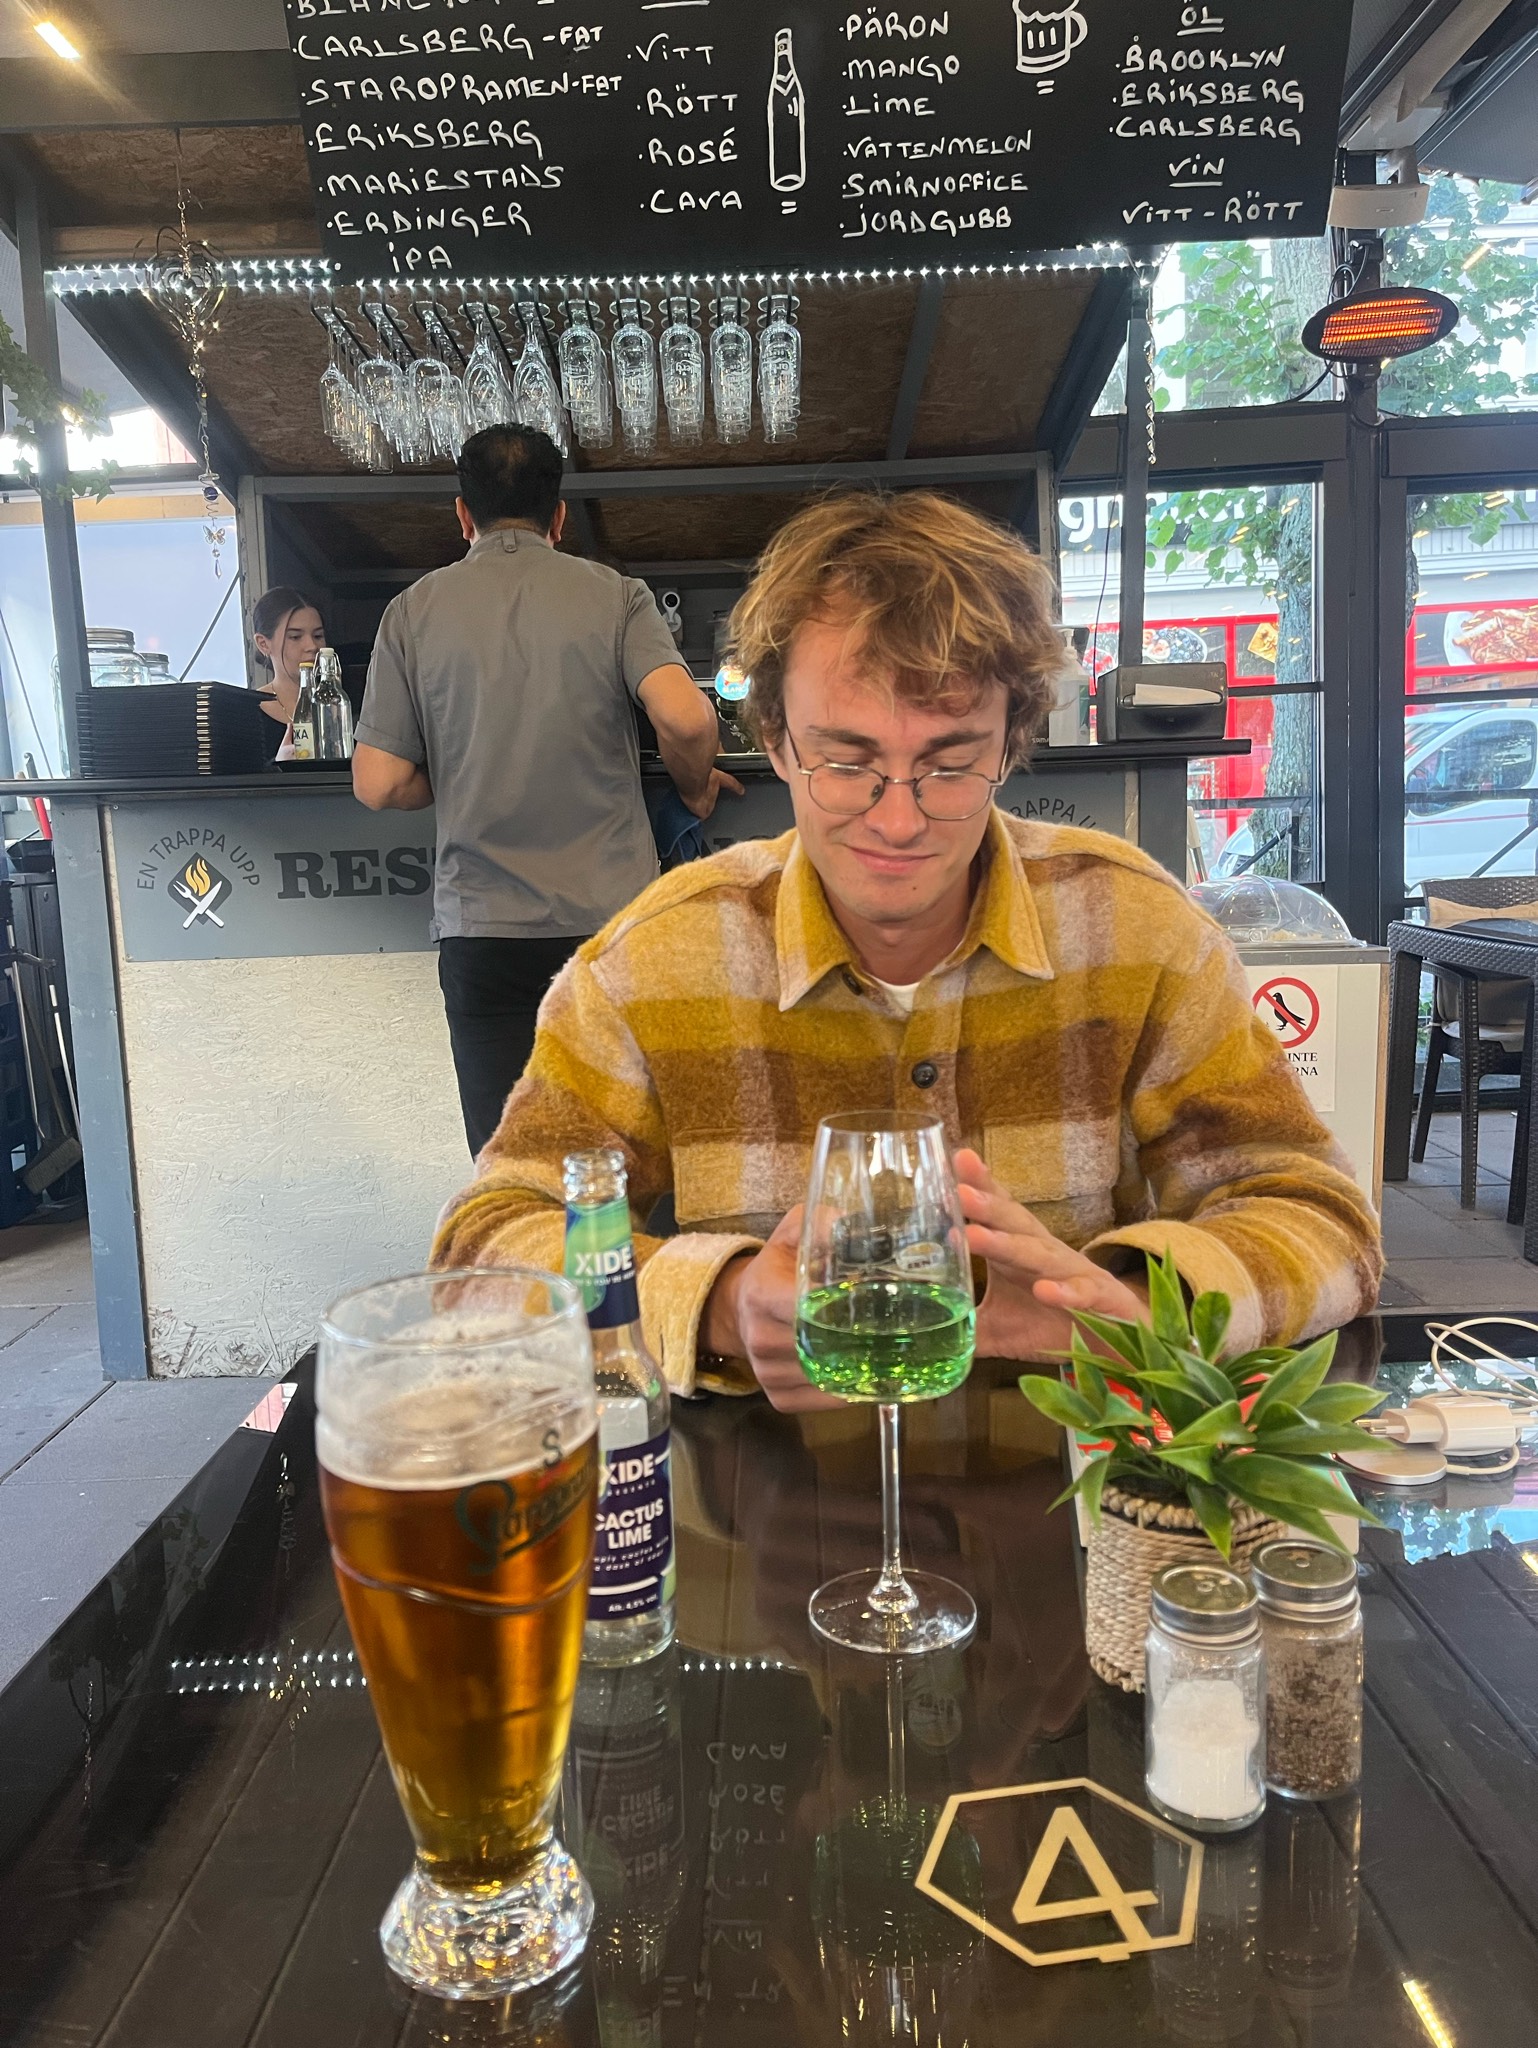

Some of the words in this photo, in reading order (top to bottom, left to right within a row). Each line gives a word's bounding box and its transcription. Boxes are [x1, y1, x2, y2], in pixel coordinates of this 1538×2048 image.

[846, 7, 949, 41] PÄRON
[297, 24, 534, 61] CARLSBERG
[1120, 43, 1287, 74] BROOKLYN
[848, 55, 960, 85] MANGO
[647, 82, 738, 119] RÖTT
[648, 126, 738, 166] ROSÉ
[848, 130, 1033, 160] VATTENMELON
[1115, 115, 1302, 146] CARLSBERG
[651, 189, 743, 214] CAVA
[1224, 191, 1304, 224] RÖTT
[137, 862, 158, 890] EN
[149, 827, 226, 860] TRAPPA
[229, 845, 260, 886] UPP
[274, 846, 437, 900] RES
[575, 1245, 633, 1276] XIDE
[598, 1453, 655, 1486] XIDE
[594, 1497, 664, 1532] CACTUS
[608, 1523, 652, 1550] LIME
